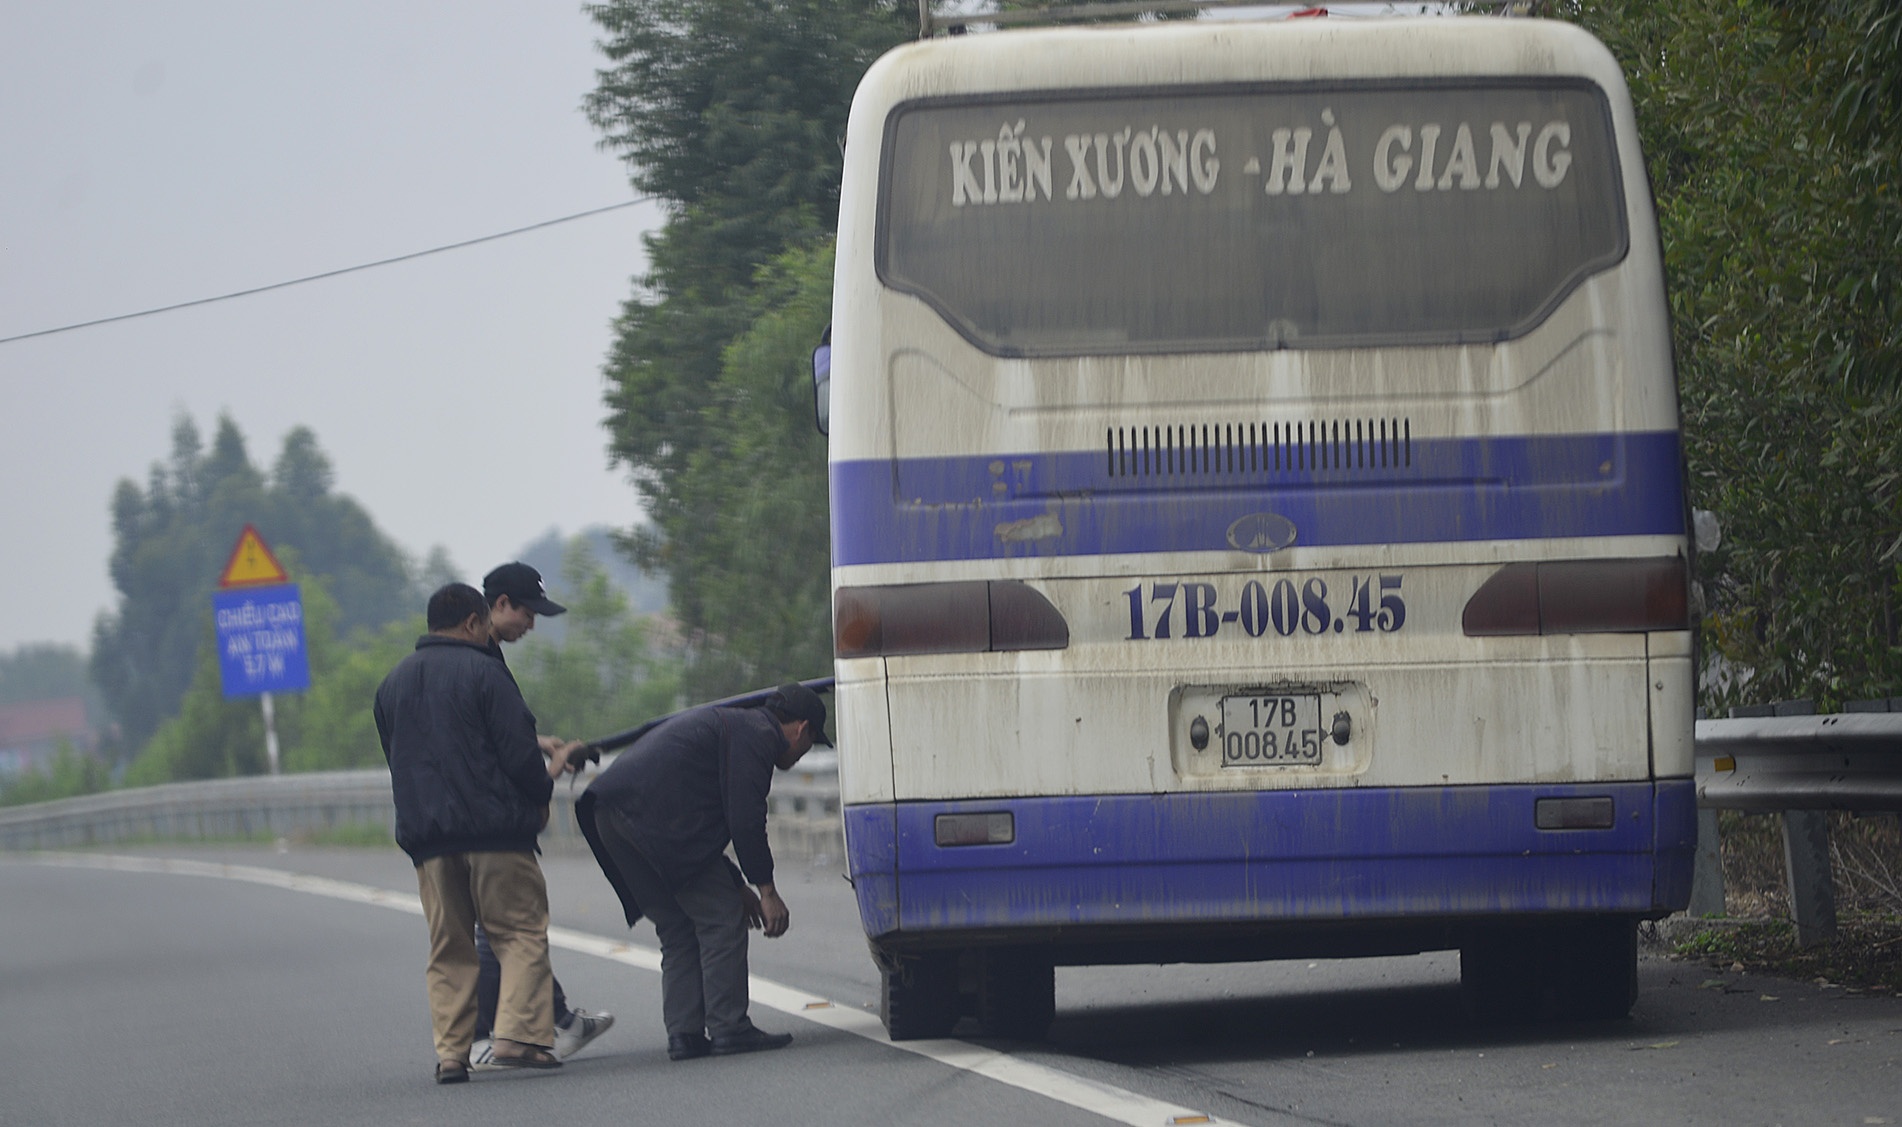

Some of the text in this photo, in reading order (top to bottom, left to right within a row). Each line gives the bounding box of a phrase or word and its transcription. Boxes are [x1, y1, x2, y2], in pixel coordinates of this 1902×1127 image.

[950, 118, 1053, 206] KIẾN
[1064, 125, 1220, 199] XƯƠNG
[1265, 108, 1351, 194] HÀ
[1373, 121, 1572, 192] GIANG
[1122, 574, 1407, 641] 17B-008.45
[1249, 698, 1297, 728] 17B
[1226, 730, 1318, 761] 008.45
